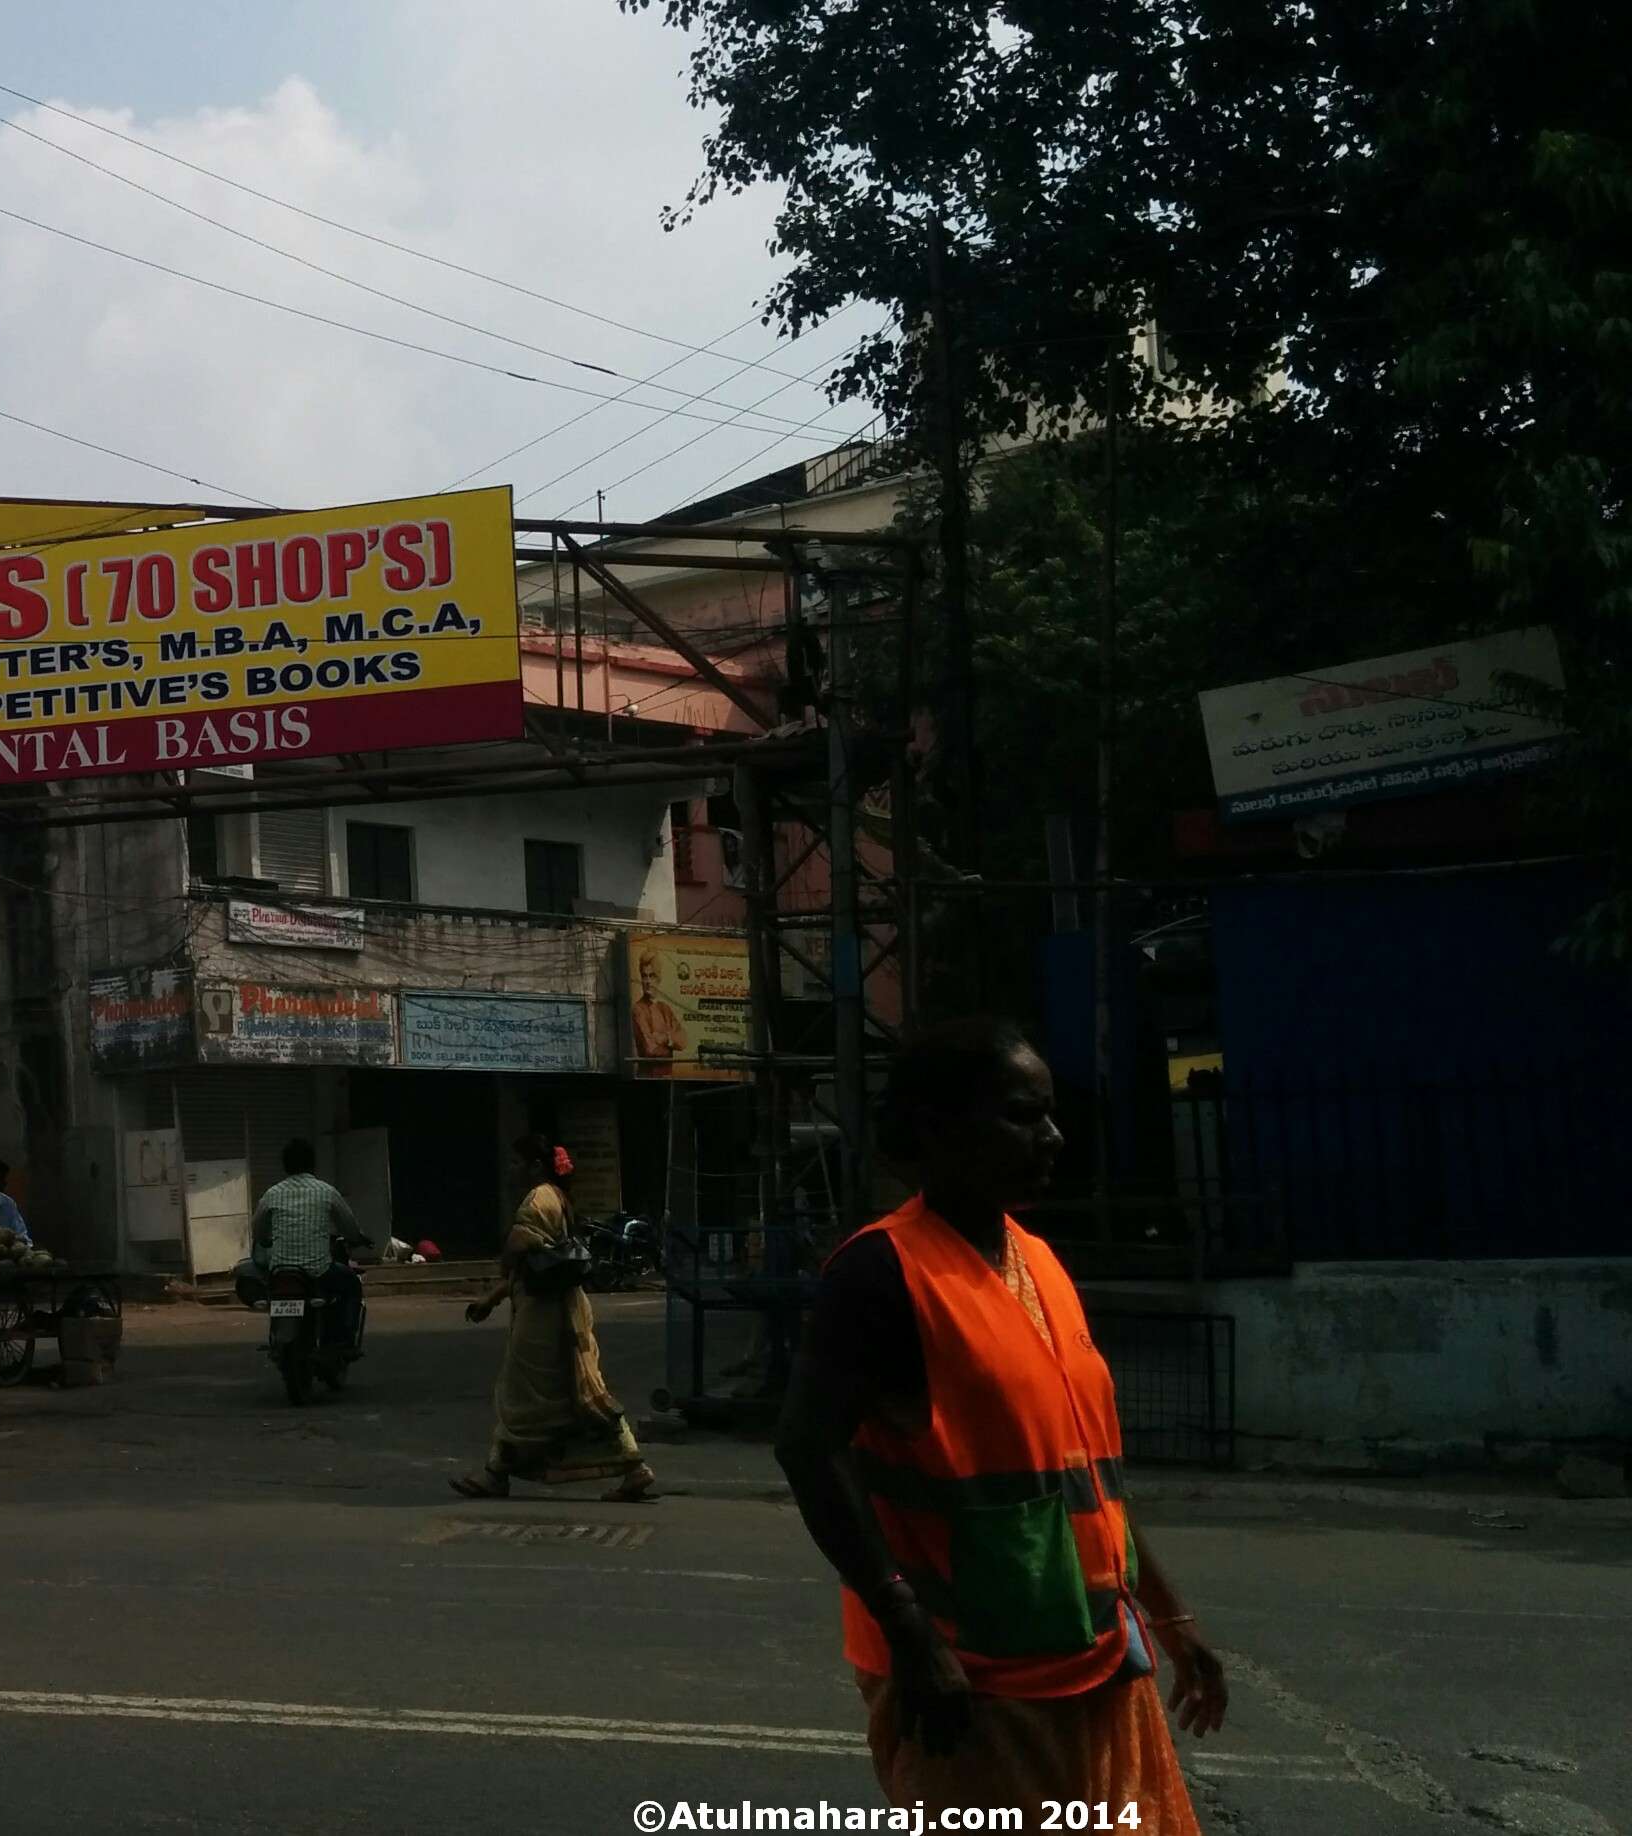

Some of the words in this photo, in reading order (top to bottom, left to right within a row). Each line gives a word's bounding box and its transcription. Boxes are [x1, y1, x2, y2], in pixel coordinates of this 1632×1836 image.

[161, 620, 309, 662] M.B.A,
[325, 603, 481, 645] M.C.A,
[246, 651, 421, 697] BOOKS
[156, 706, 311, 760] BASIS
